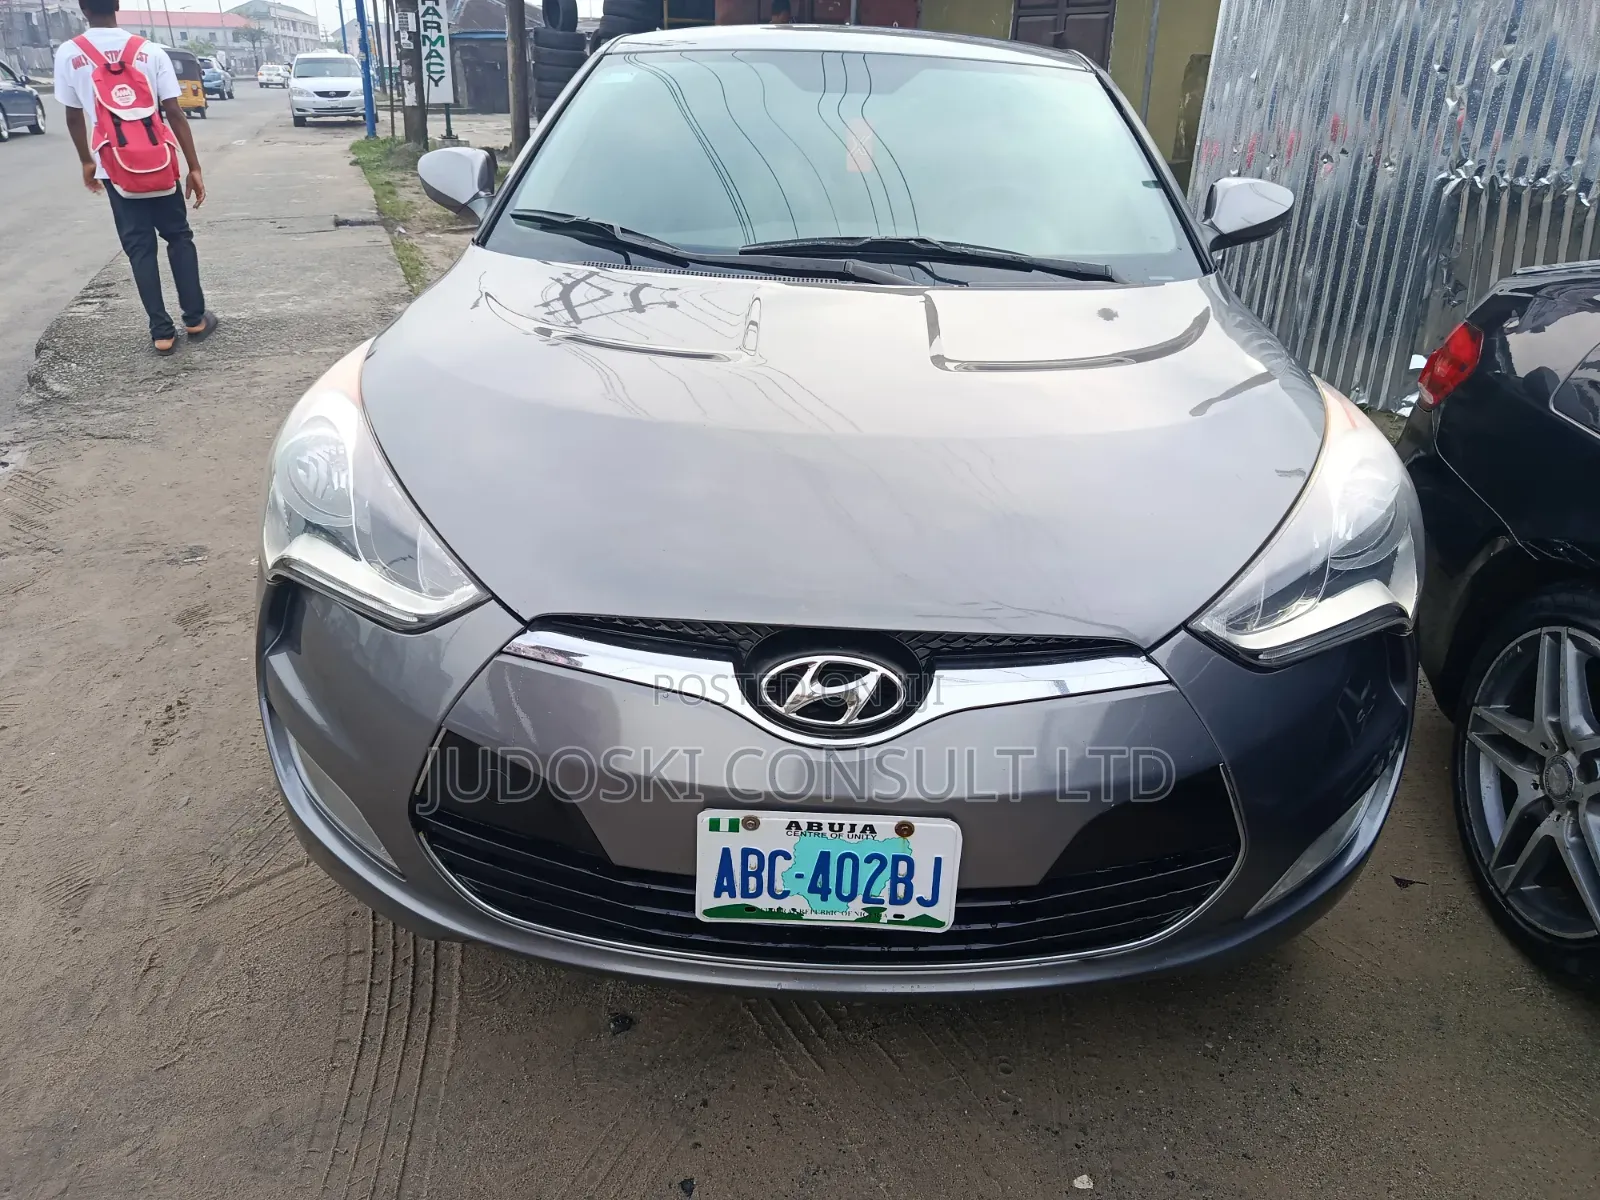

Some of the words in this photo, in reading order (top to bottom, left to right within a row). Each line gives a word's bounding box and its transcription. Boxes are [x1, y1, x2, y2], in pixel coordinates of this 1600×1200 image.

[785, 820, 878, 835] ABUJA
[786, 830, 828, 839] CENTRE
[830, 832, 844, 840] OF
[847, 833, 878, 841] UNITY
[713, 846, 943, 908] ABC-402BJ
